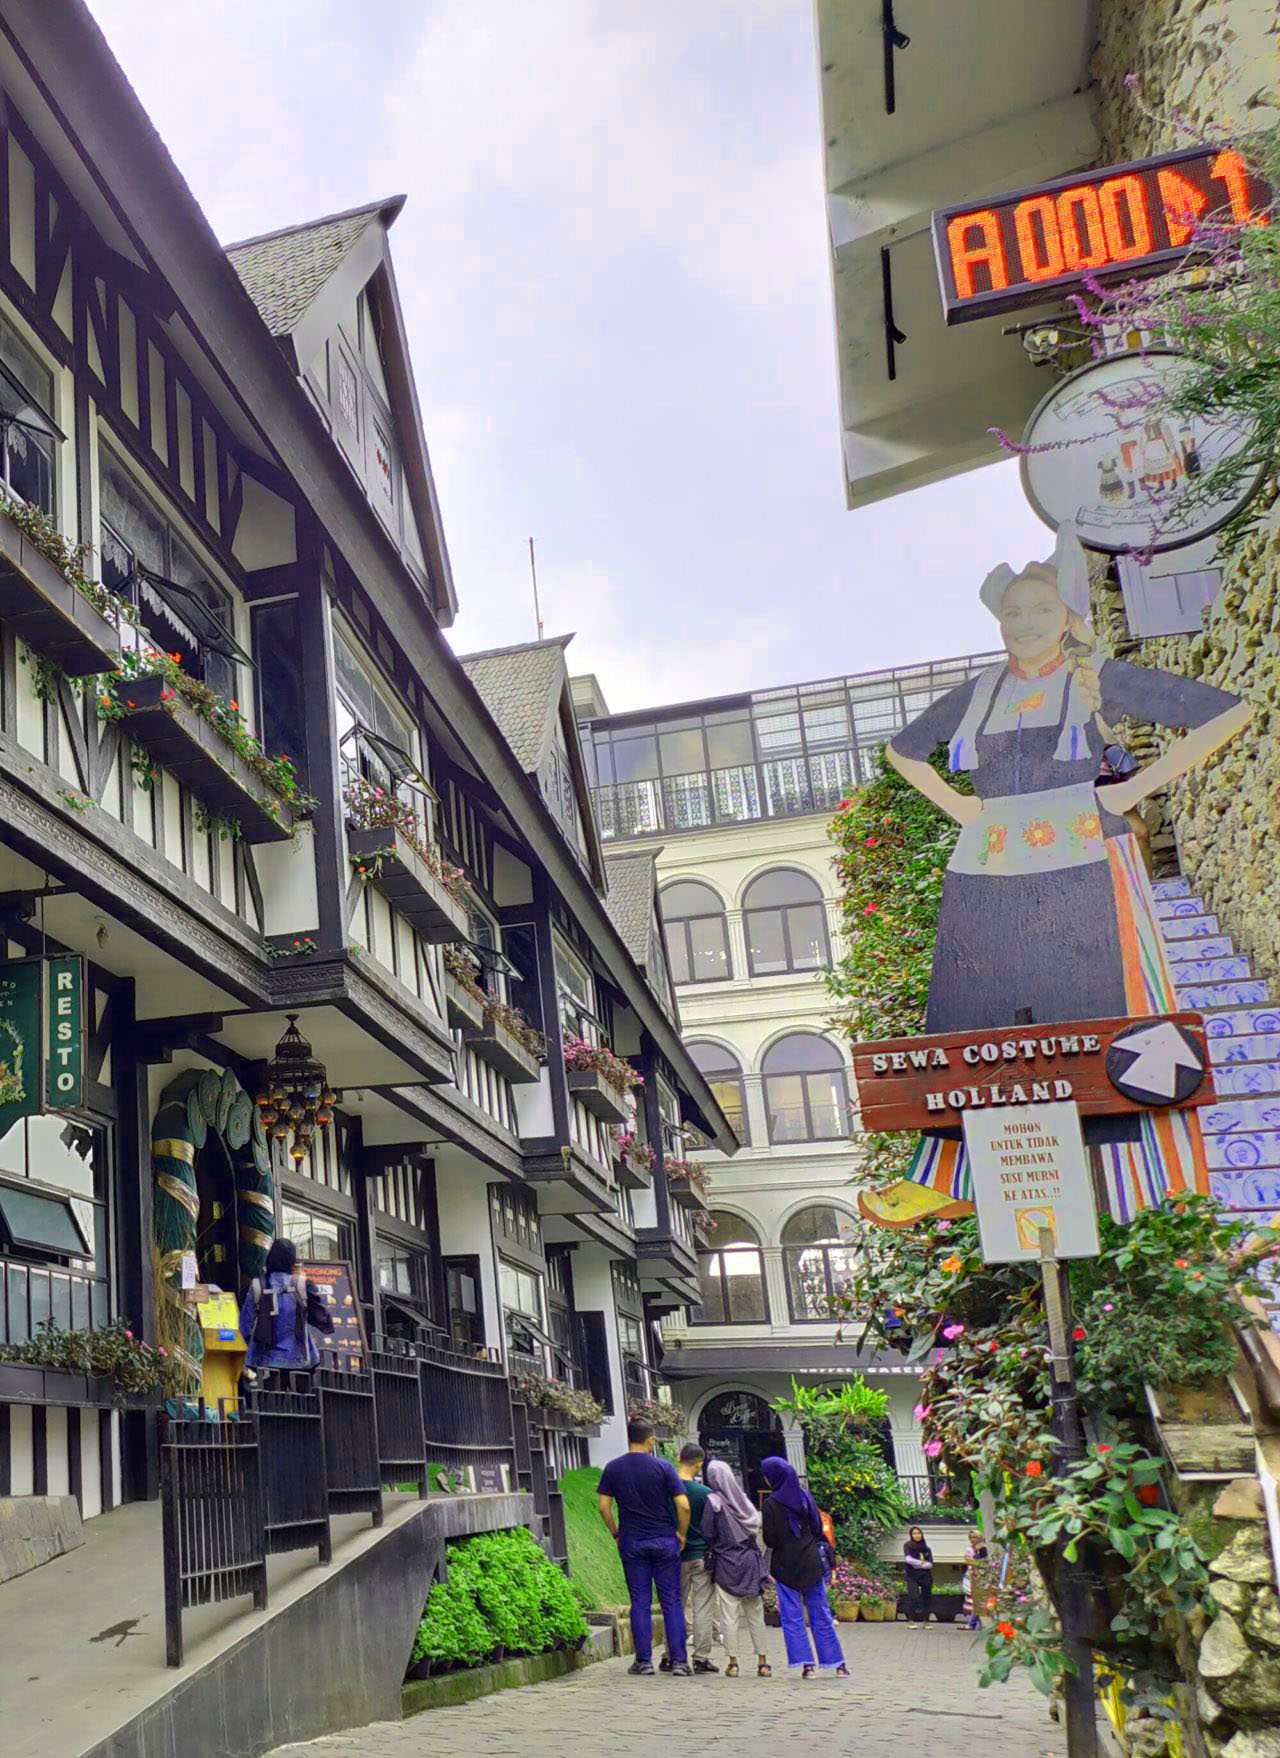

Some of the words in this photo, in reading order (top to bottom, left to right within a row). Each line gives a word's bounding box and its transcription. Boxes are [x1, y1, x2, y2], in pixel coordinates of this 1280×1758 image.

[57, 972, 74, 1092] RESTO
[872, 1048, 949, 1073] SEWA
[963, 1035, 1101, 1064] COSTUME
[926, 1079, 1073, 1110] HOLLAND
[1003, 1122, 1041, 1135] MOHON
[990, 1138, 1023, 1151] UNTUK
[1027, 1136, 1059, 1148] TIDAK
[1000, 1152, 1054, 1166] MEMBAWA
[1000, 1173, 1023, 1184] SUSU
[1026, 1170, 1060, 1181] MURNI
[1004, 1190, 1018, 1201] KE
